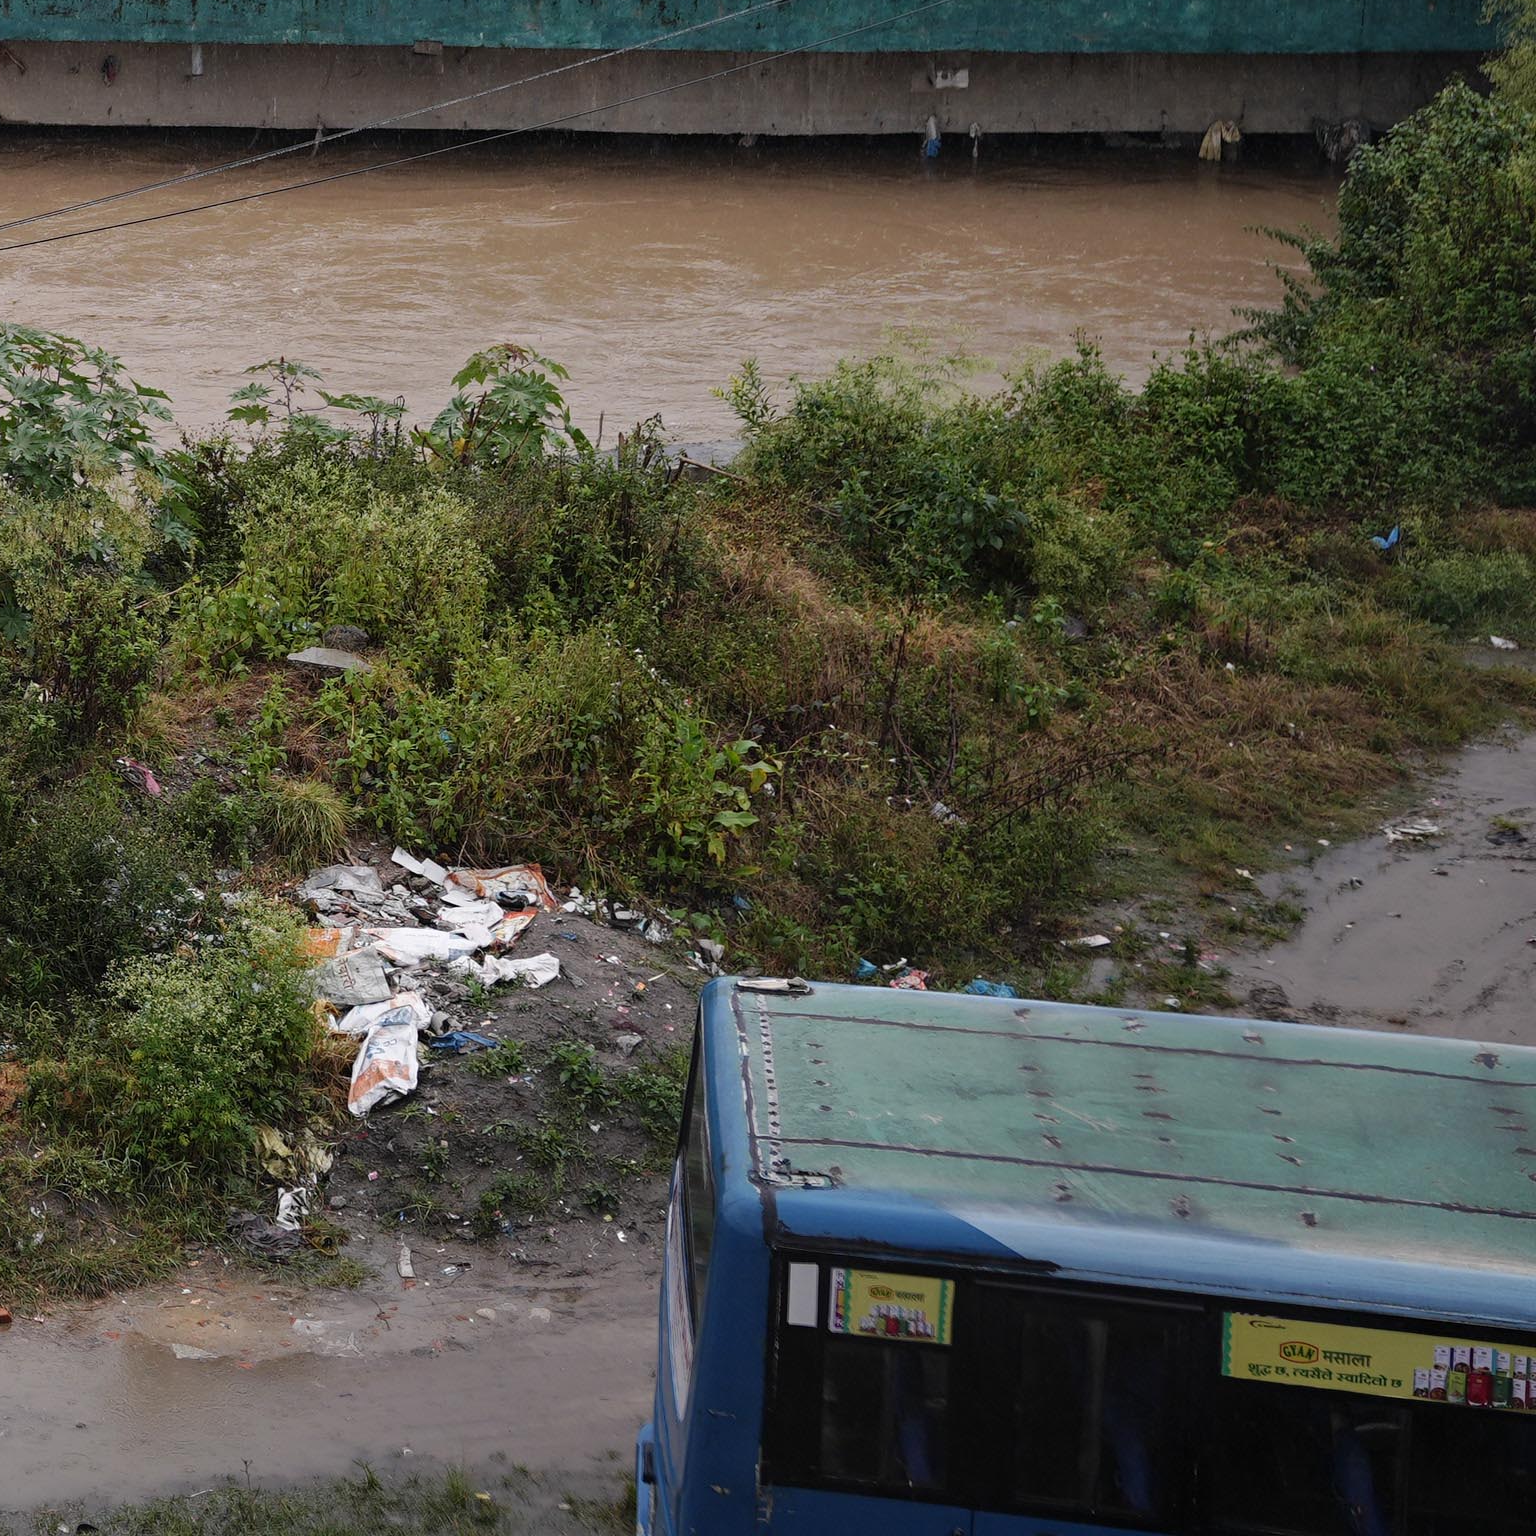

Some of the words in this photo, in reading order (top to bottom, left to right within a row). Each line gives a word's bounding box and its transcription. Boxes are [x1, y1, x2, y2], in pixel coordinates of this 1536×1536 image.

[1283, 1345, 1315, 1360] GYAN
[1321, 1350, 1371, 1367] मसाला
[1248, 1363, 1271, 1376] शुद्ध
[1391, 1379, 1403, 1387] छ
